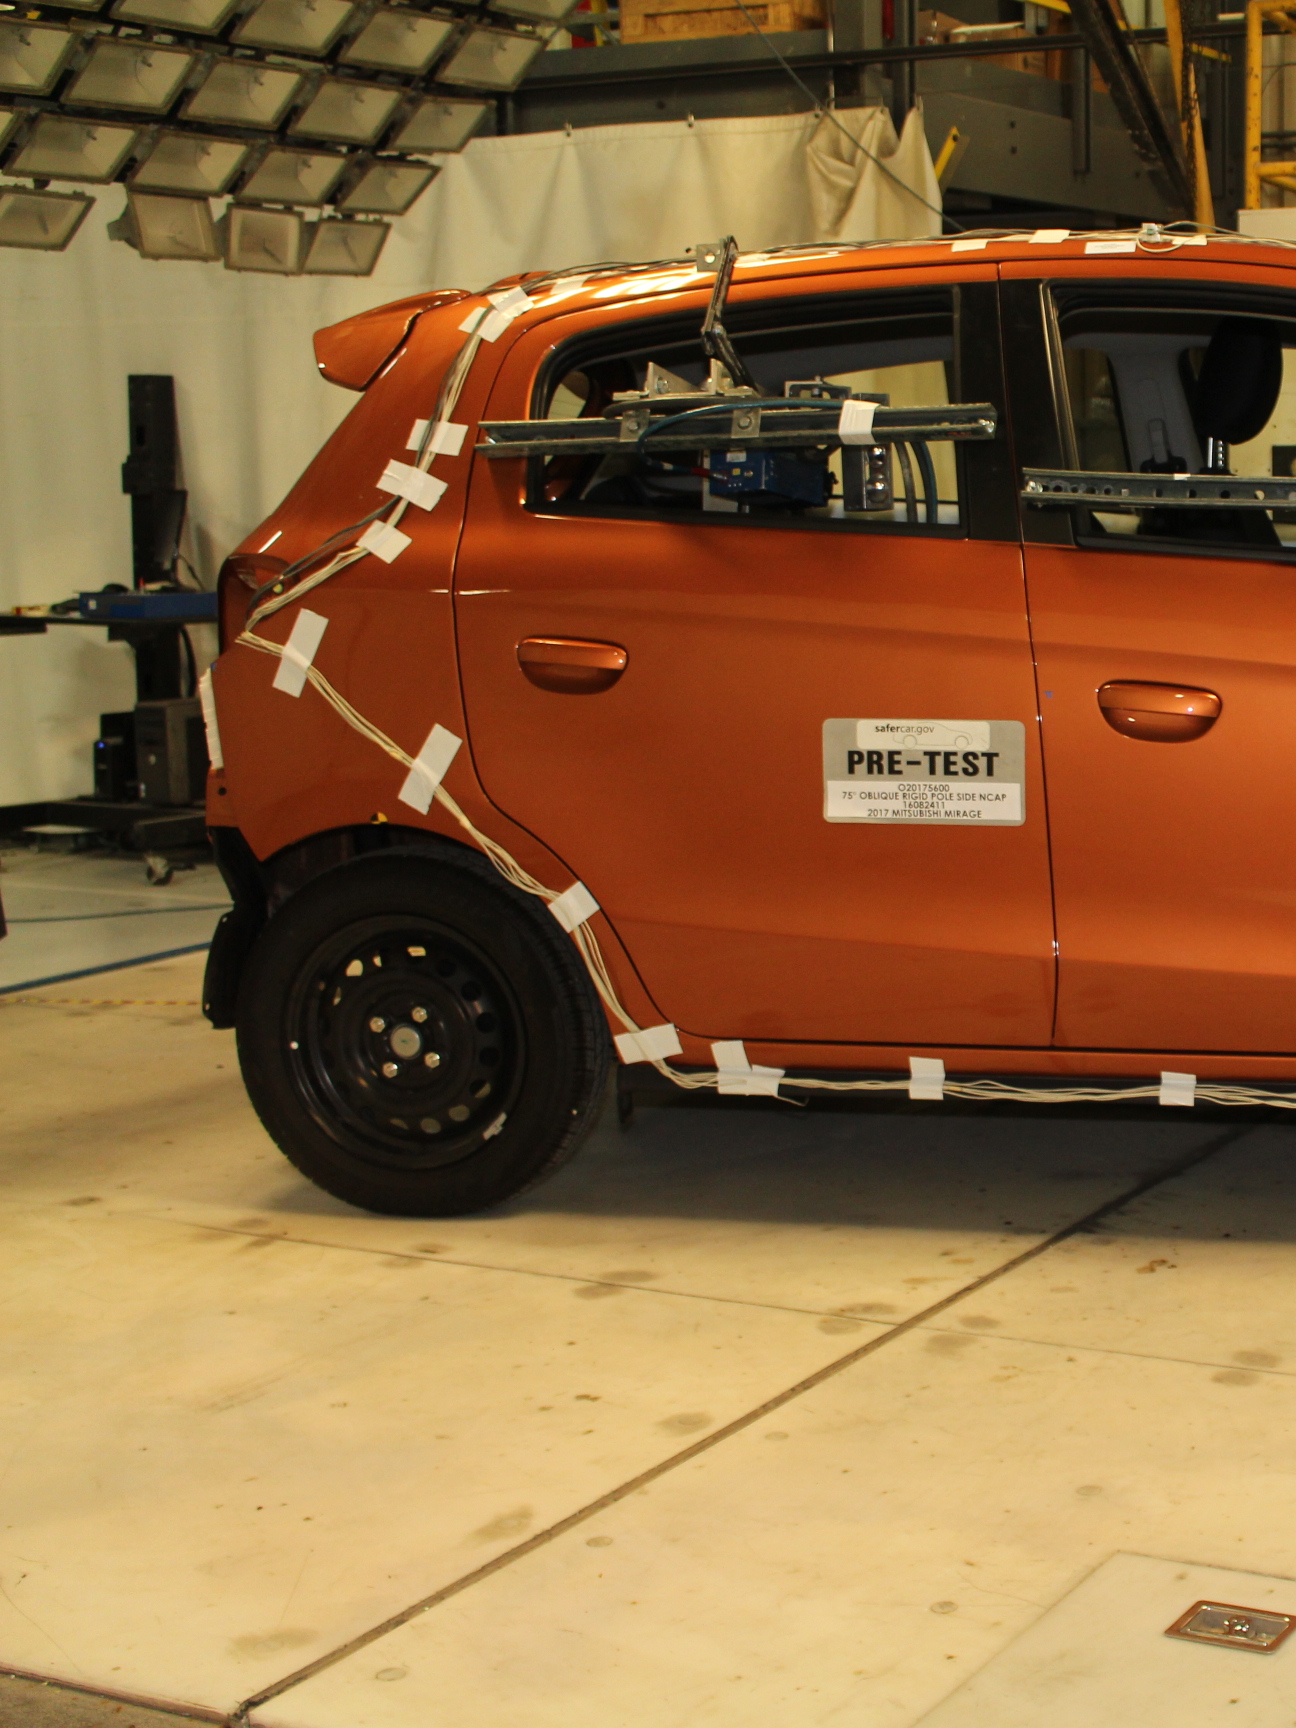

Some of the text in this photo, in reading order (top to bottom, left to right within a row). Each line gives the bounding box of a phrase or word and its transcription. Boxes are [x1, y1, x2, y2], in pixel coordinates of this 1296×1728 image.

[875, 723, 935, 736] safercar.gov
[847, 750, 1000, 777] PRE-TEST
[842, 791, 1007, 802] 75° OBLIQUE RIGID POLE SIDE NCAP
[903, 801, 945, 809] 16082411
[867, 809, 982, 818] 2017 MITSUBISHI MIRAGE
